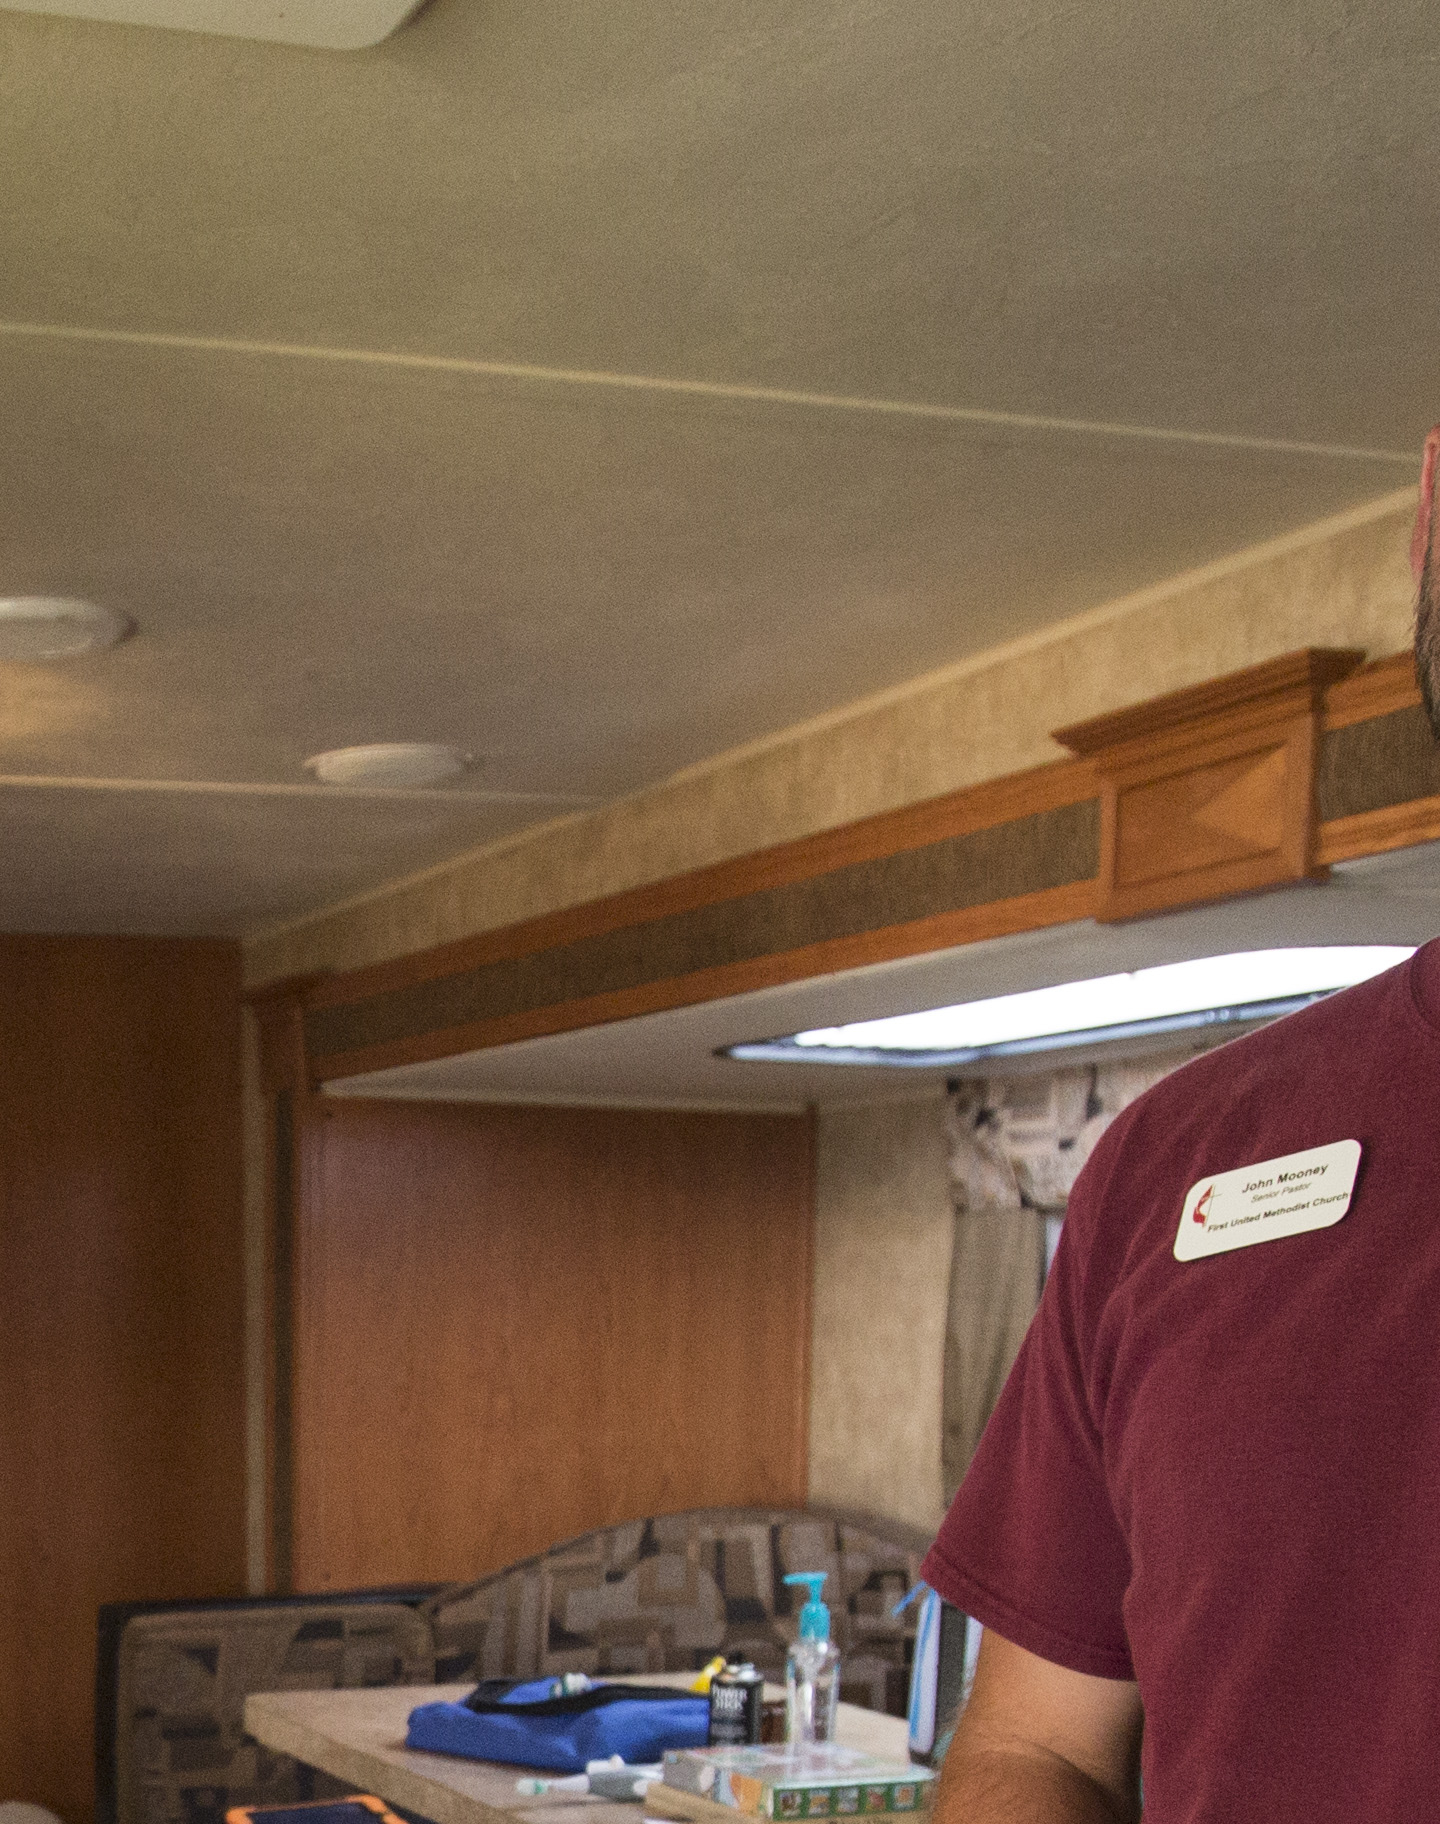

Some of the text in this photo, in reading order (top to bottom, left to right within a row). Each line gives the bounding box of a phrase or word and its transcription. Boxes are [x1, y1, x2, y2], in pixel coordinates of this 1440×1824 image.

[1241, 1164, 1329, 1194] John Mooney
[1251, 1182, 1313, 1204] Senior Pastor
[1206, 1191, 1349, 1233] First United Methodist Church
